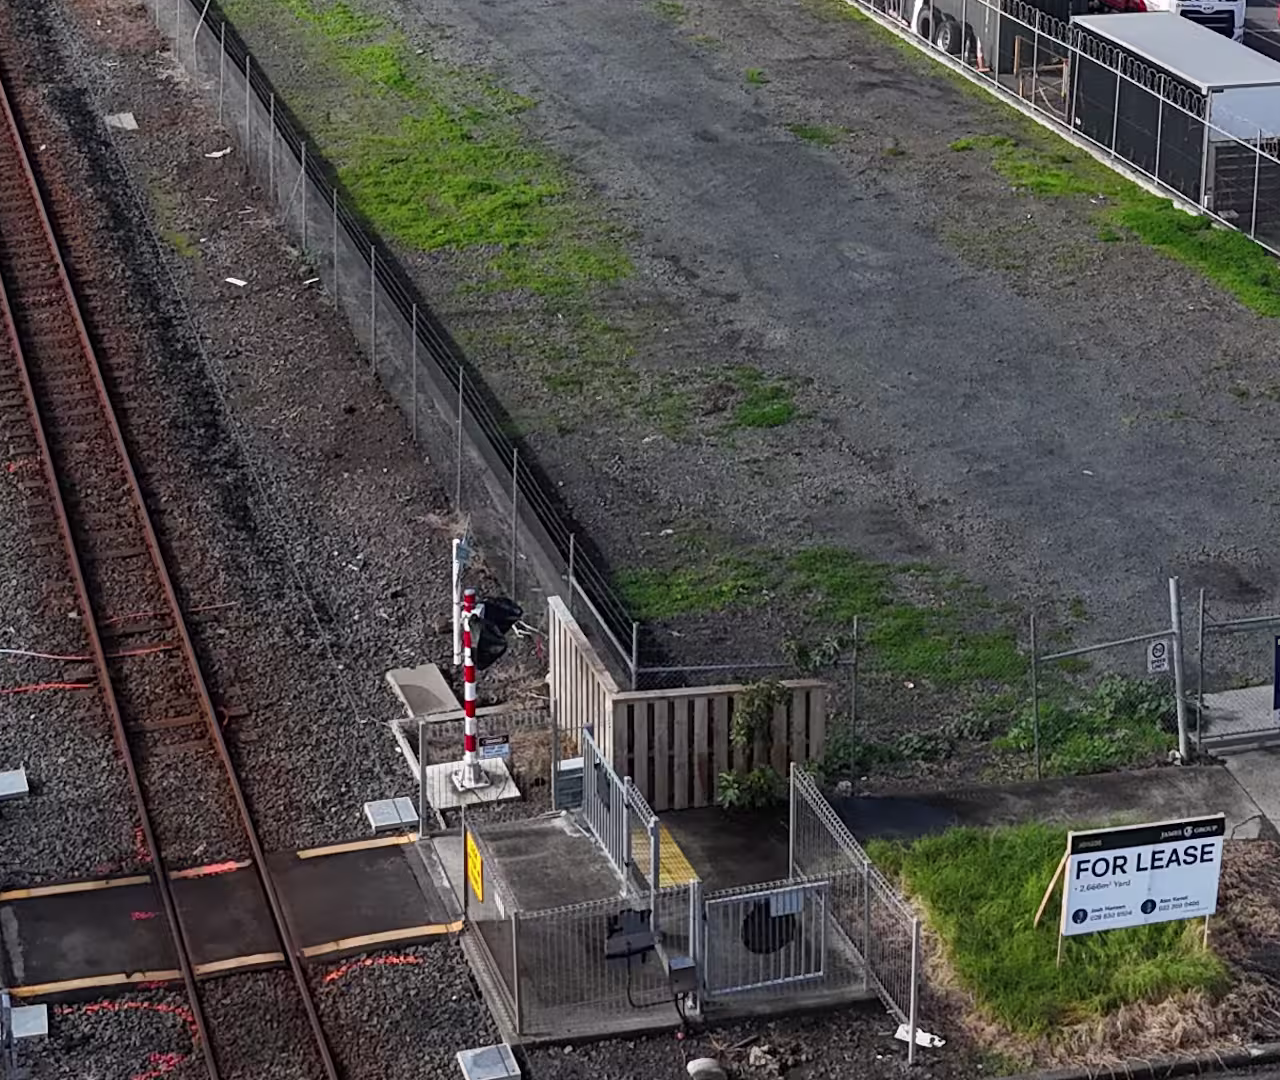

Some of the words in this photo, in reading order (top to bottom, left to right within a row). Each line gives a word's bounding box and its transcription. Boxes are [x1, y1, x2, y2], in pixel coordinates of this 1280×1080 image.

[1193, 824, 1218, 834] GROUP
[1075, 855, 1128, 880] FOR
[1135, 842, 1216, 873] LEASE
